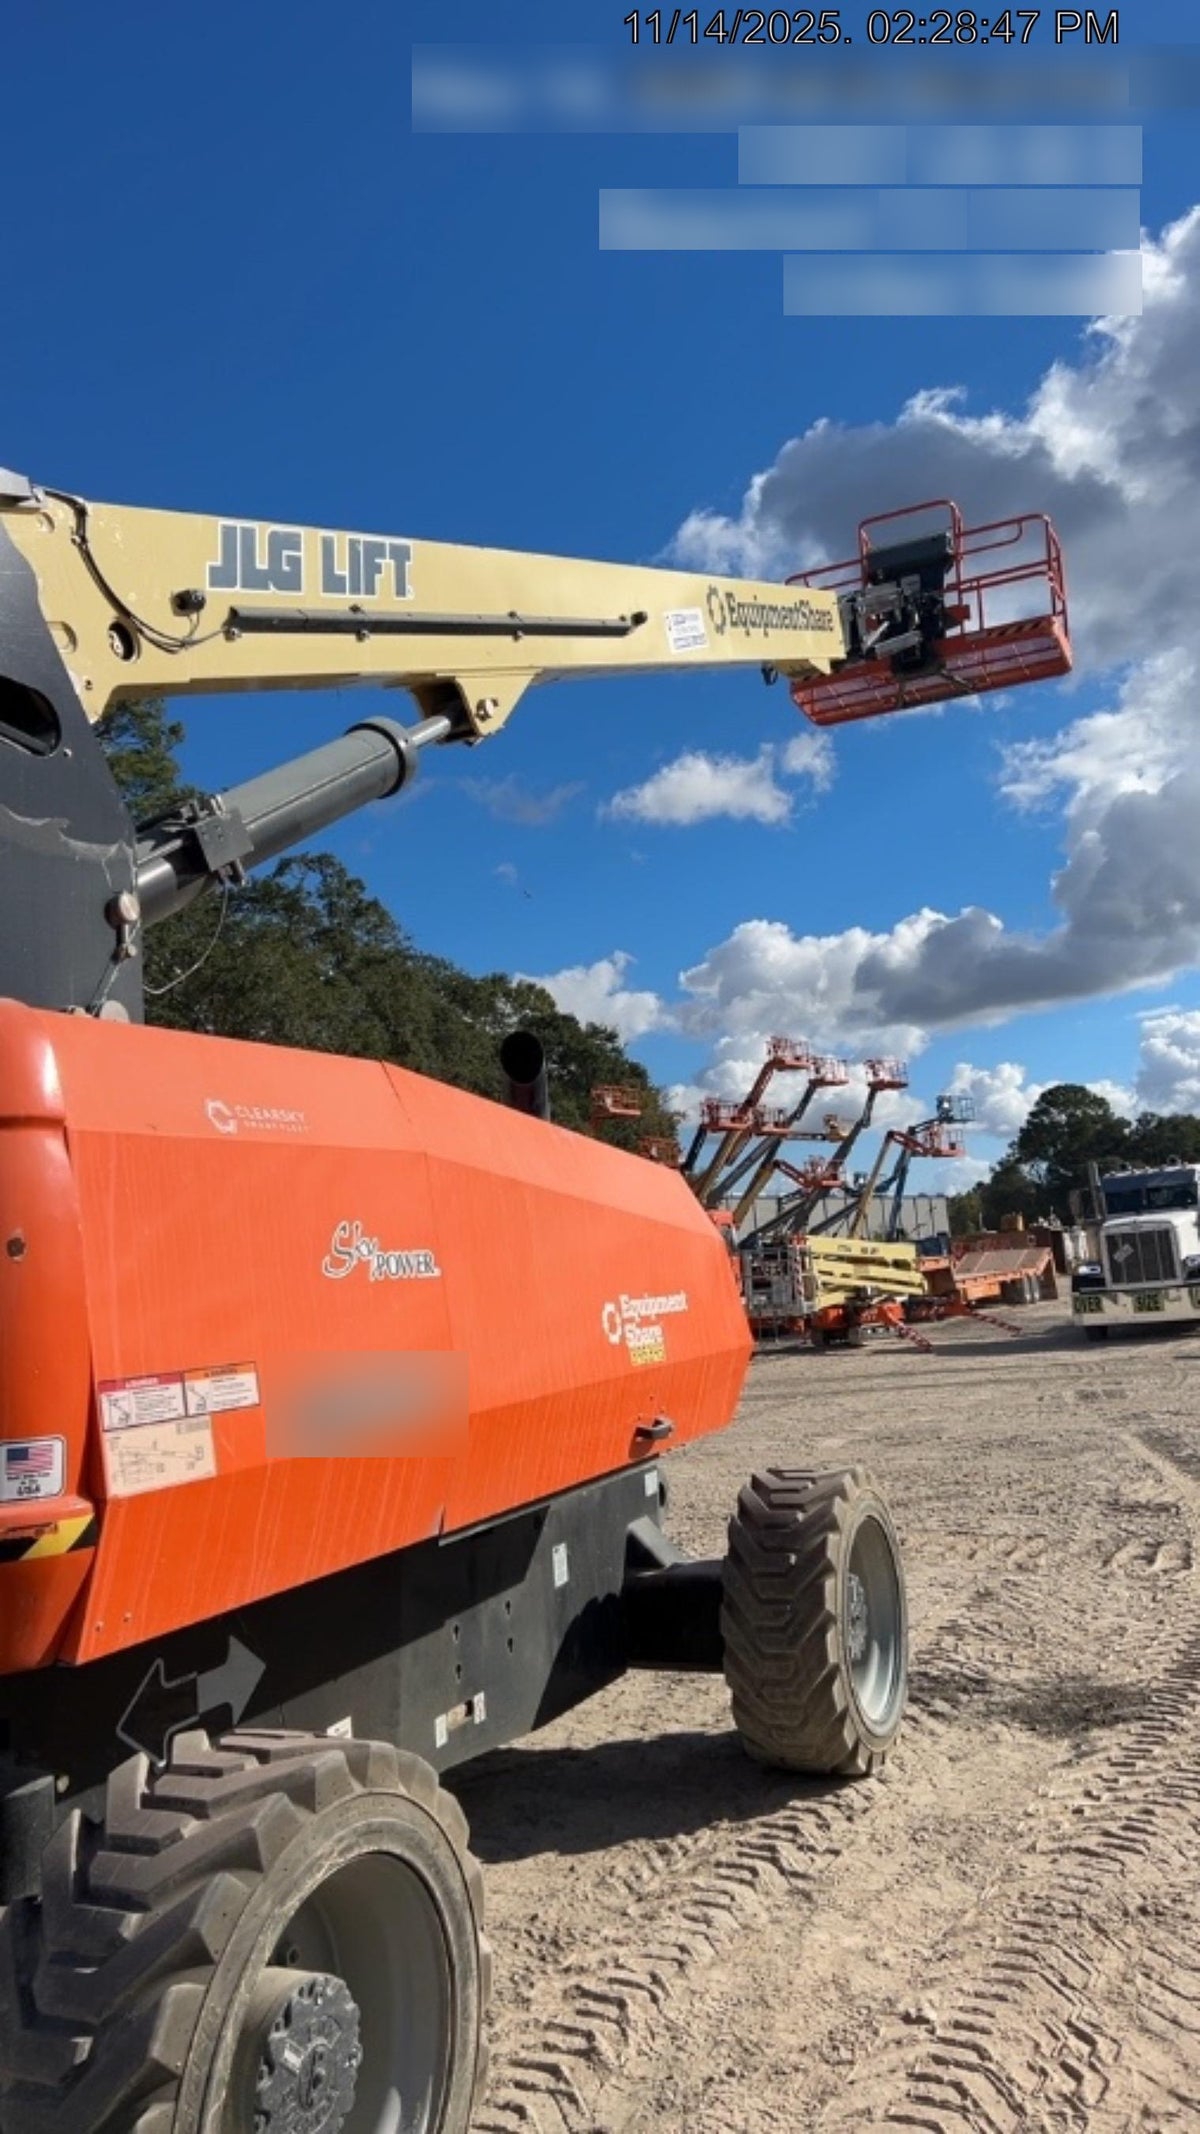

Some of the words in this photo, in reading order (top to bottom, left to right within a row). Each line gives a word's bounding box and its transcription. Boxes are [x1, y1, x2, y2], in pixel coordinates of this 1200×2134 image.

[206, 520, 304, 596] JLG
[319, 532, 411, 600] LIFT
[725, 592, 834, 637] EquipmentShare
[619, 1290, 688, 1322] Equipment
[625, 1322, 664, 1348] Share
